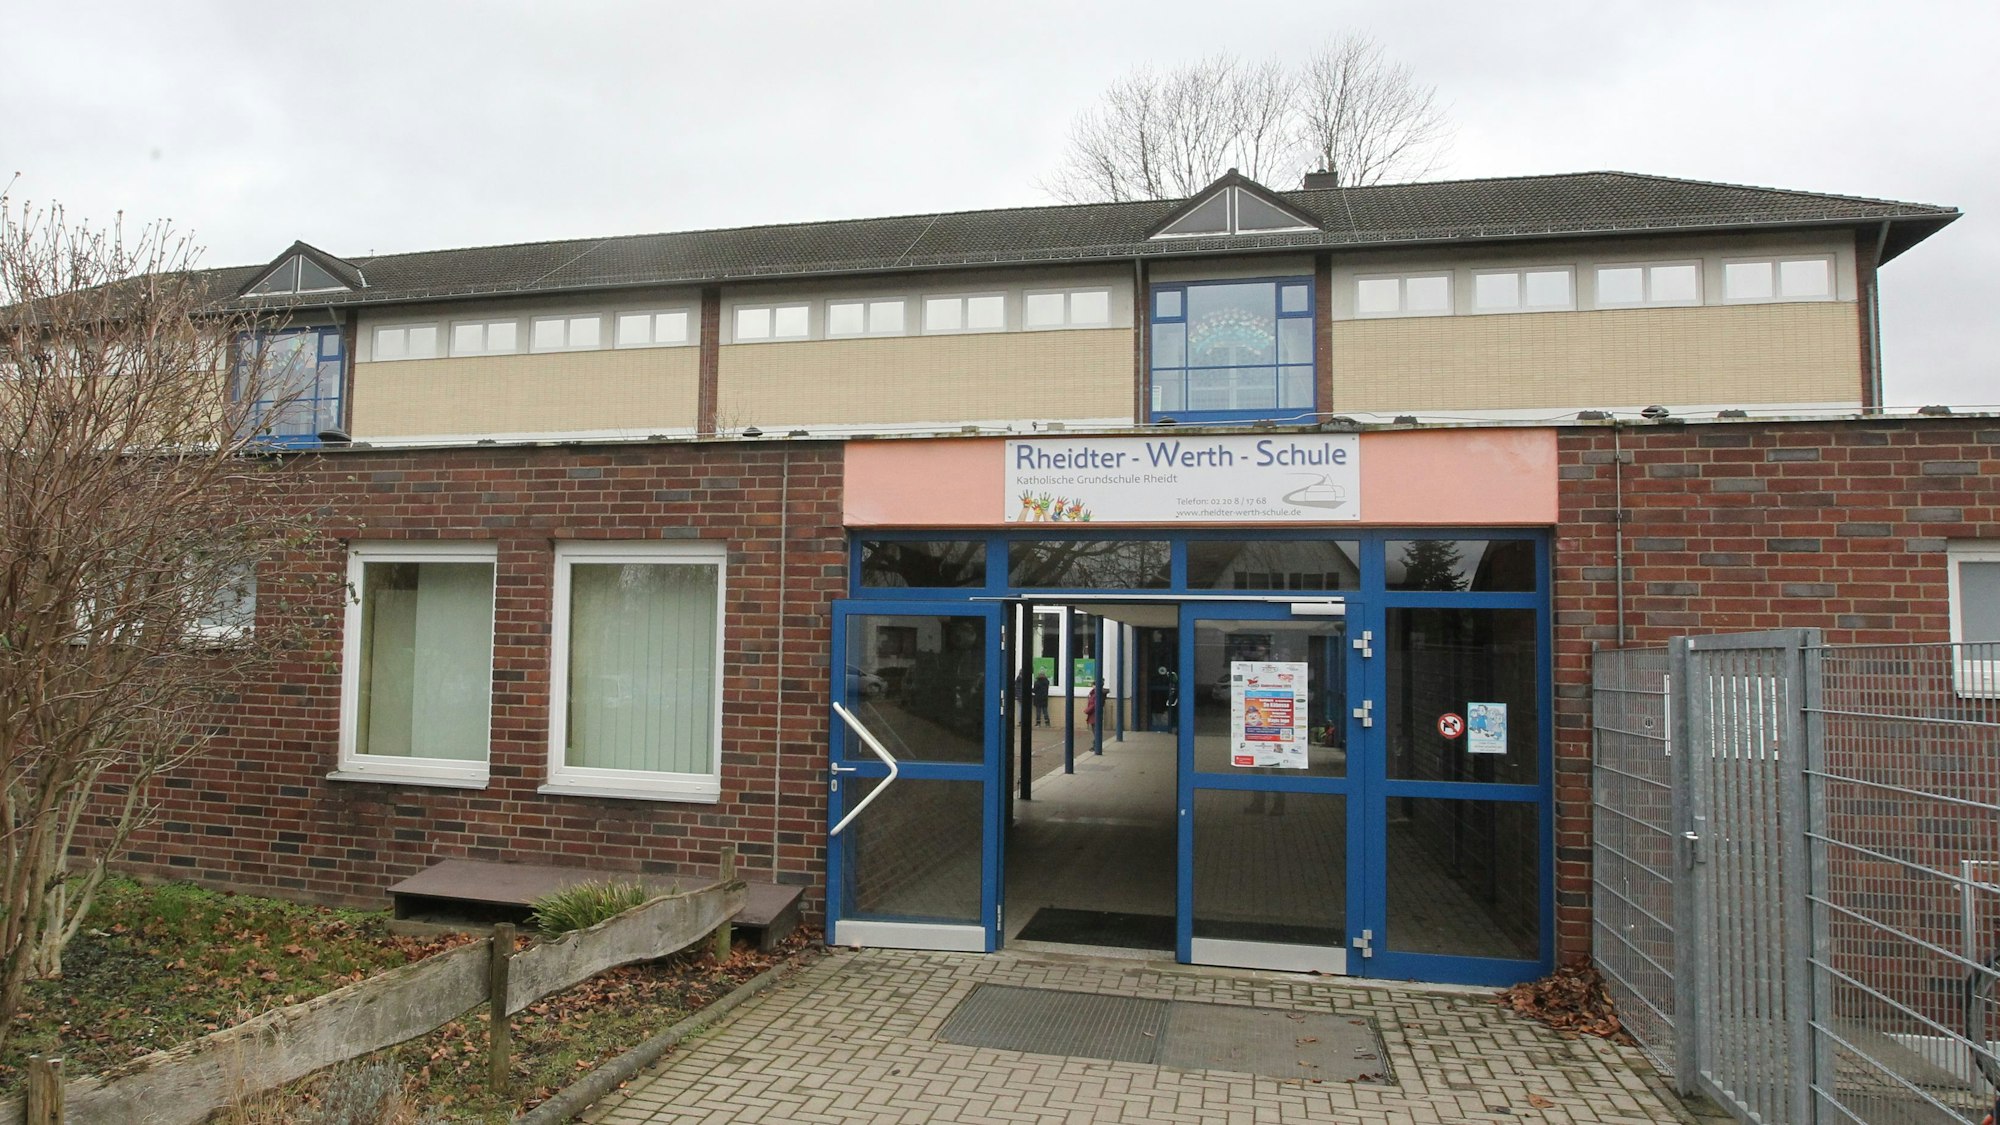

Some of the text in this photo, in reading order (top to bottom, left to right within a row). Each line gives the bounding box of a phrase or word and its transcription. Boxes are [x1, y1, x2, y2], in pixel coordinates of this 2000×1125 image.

[1016, 444, 1126, 469] Rheidter
[1146, 440, 1233, 468] Werth
[1256, 439, 1347, 466] Schule
[1016, 474, 1178, 486] Katholische Grundschule Rheidt
[1177, 498, 1209, 506] Telefon:
[1176, 507, 1302, 517] www.rheidter-werth-schule.de
